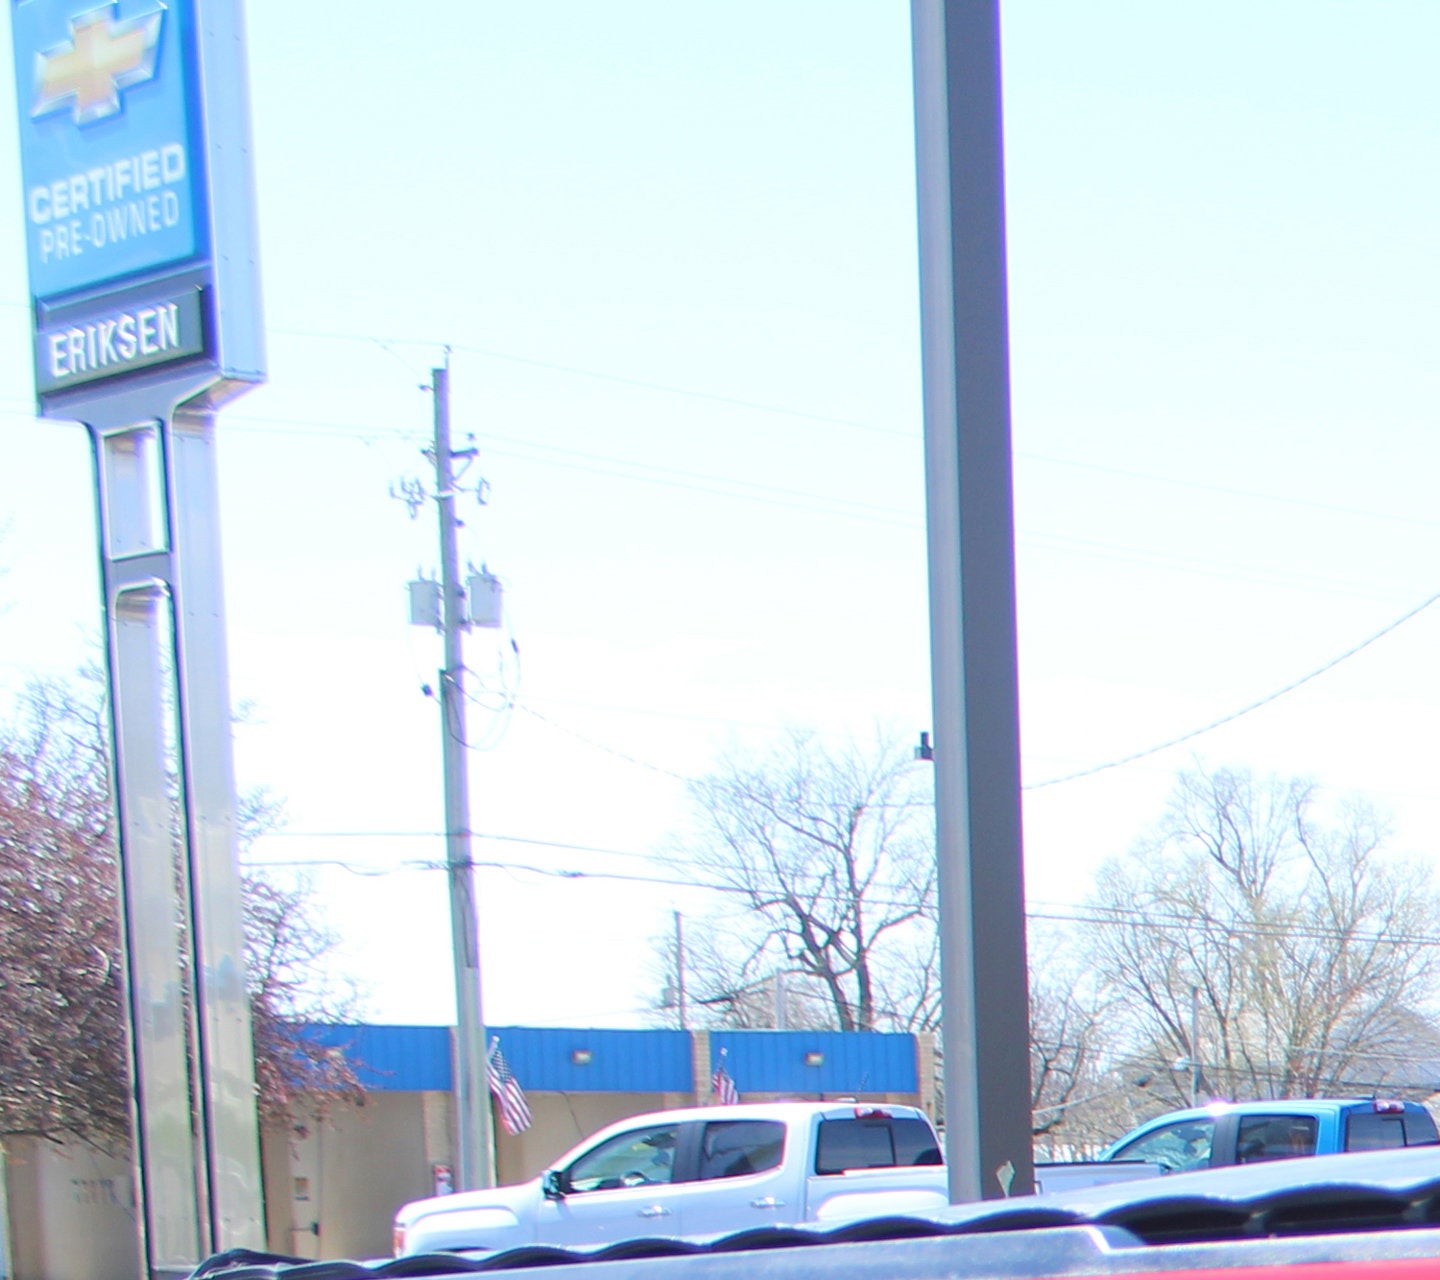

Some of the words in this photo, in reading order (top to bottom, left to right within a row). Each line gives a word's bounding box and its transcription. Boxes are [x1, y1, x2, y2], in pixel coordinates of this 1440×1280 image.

[29, 143, 187, 224] CERTIFIED
[40, 190, 180, 263] PRE-OWNED
[49, 303, 181, 378] ERIKSEN
